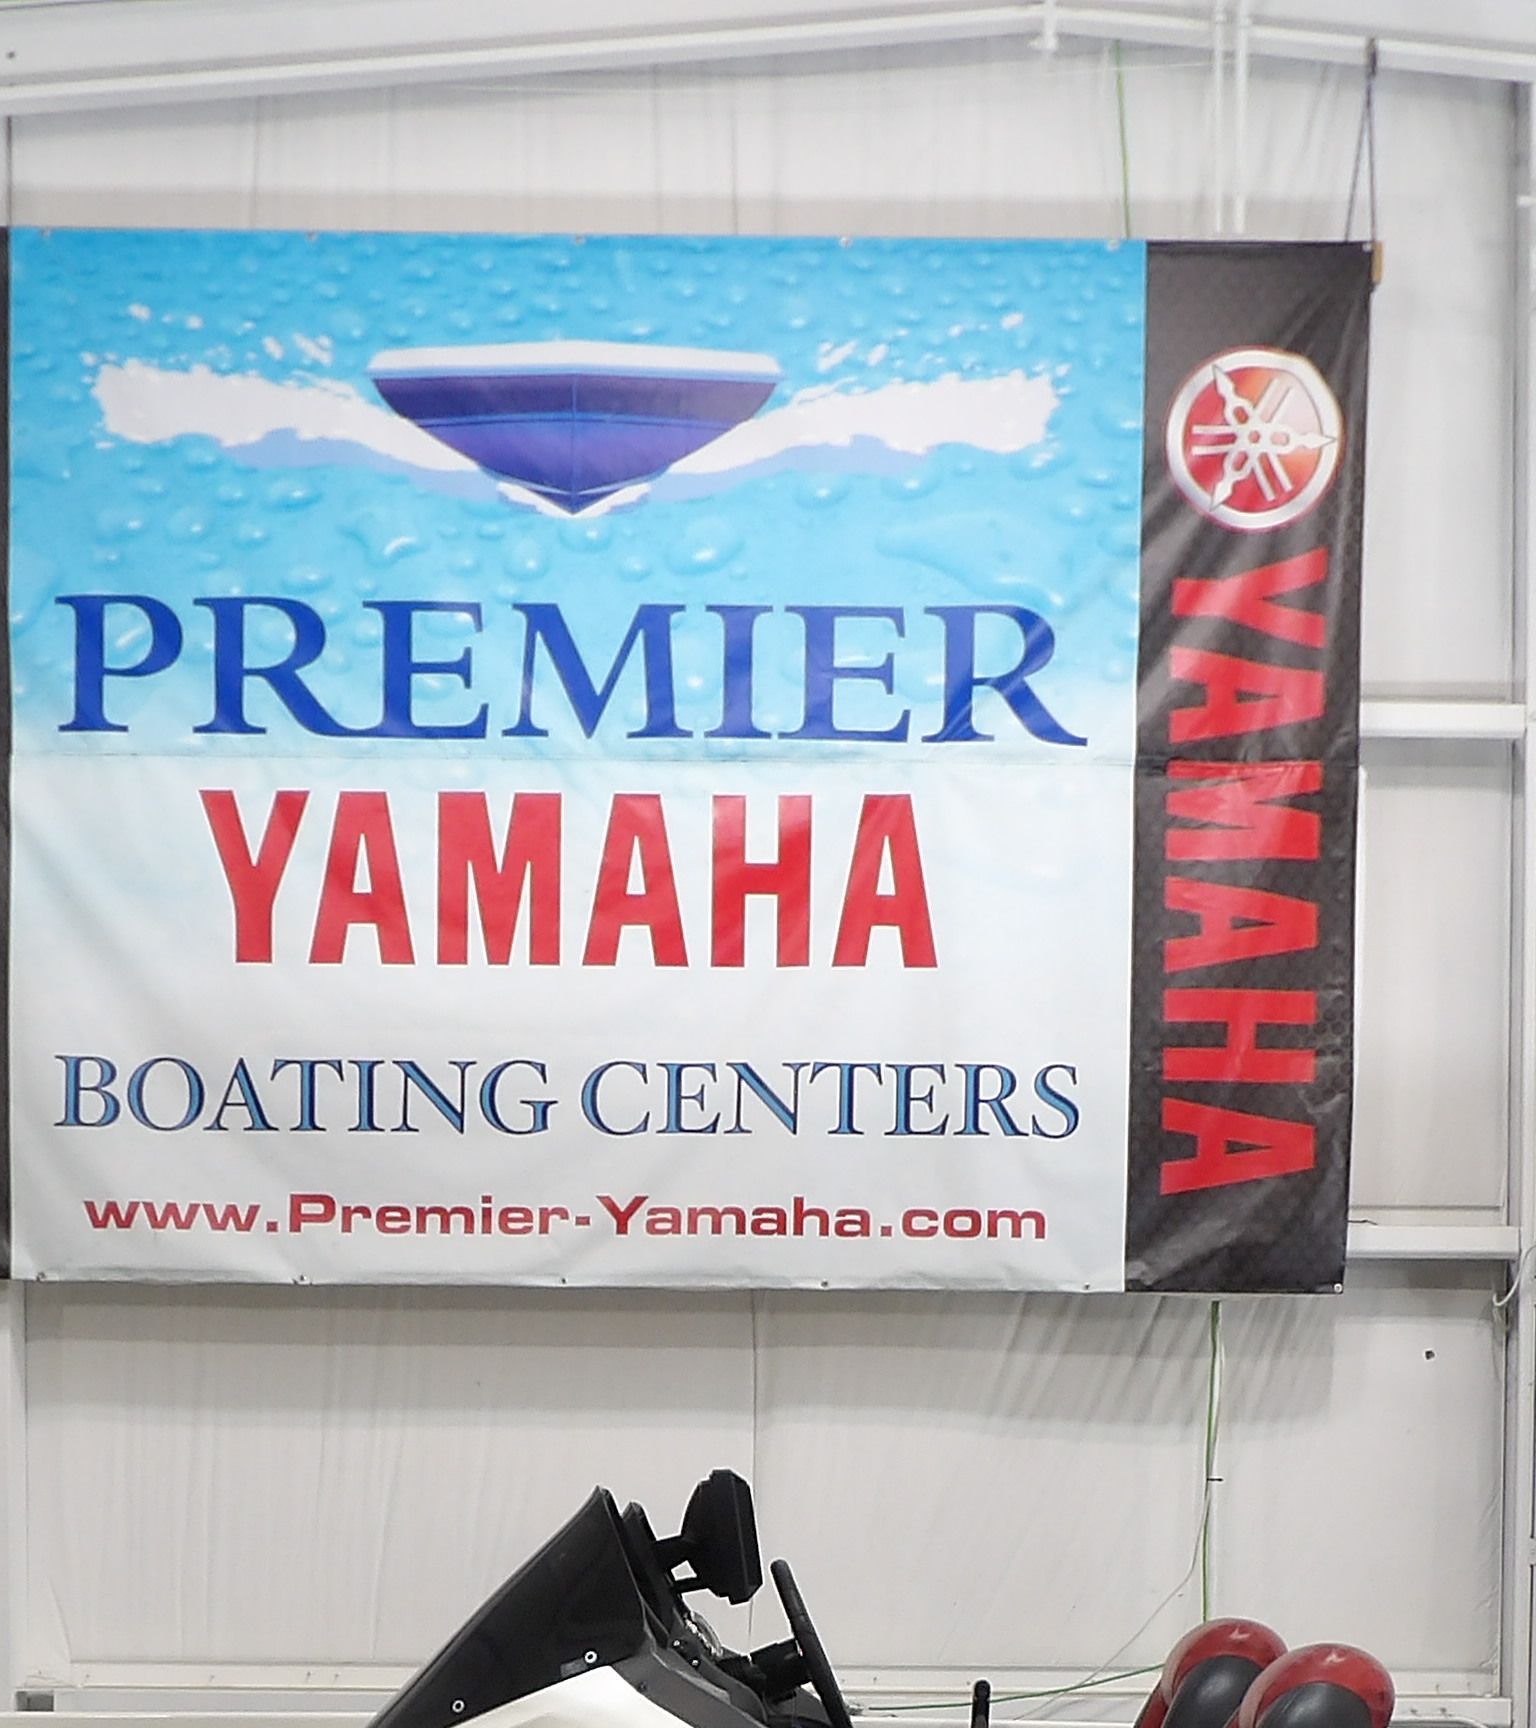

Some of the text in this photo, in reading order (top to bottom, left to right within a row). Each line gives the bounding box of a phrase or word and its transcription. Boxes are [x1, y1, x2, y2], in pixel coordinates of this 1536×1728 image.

[54, 593, 1089, 747] PREMIER
[198, 789, 938, 968] YAMAHA
[1160, 546, 1329, 1196] YAMAHA
[54, 1054, 1081, 1140] BOATING CENTERS
[83, 1193, 1047, 1242] www.Premier-Yamaha.com
